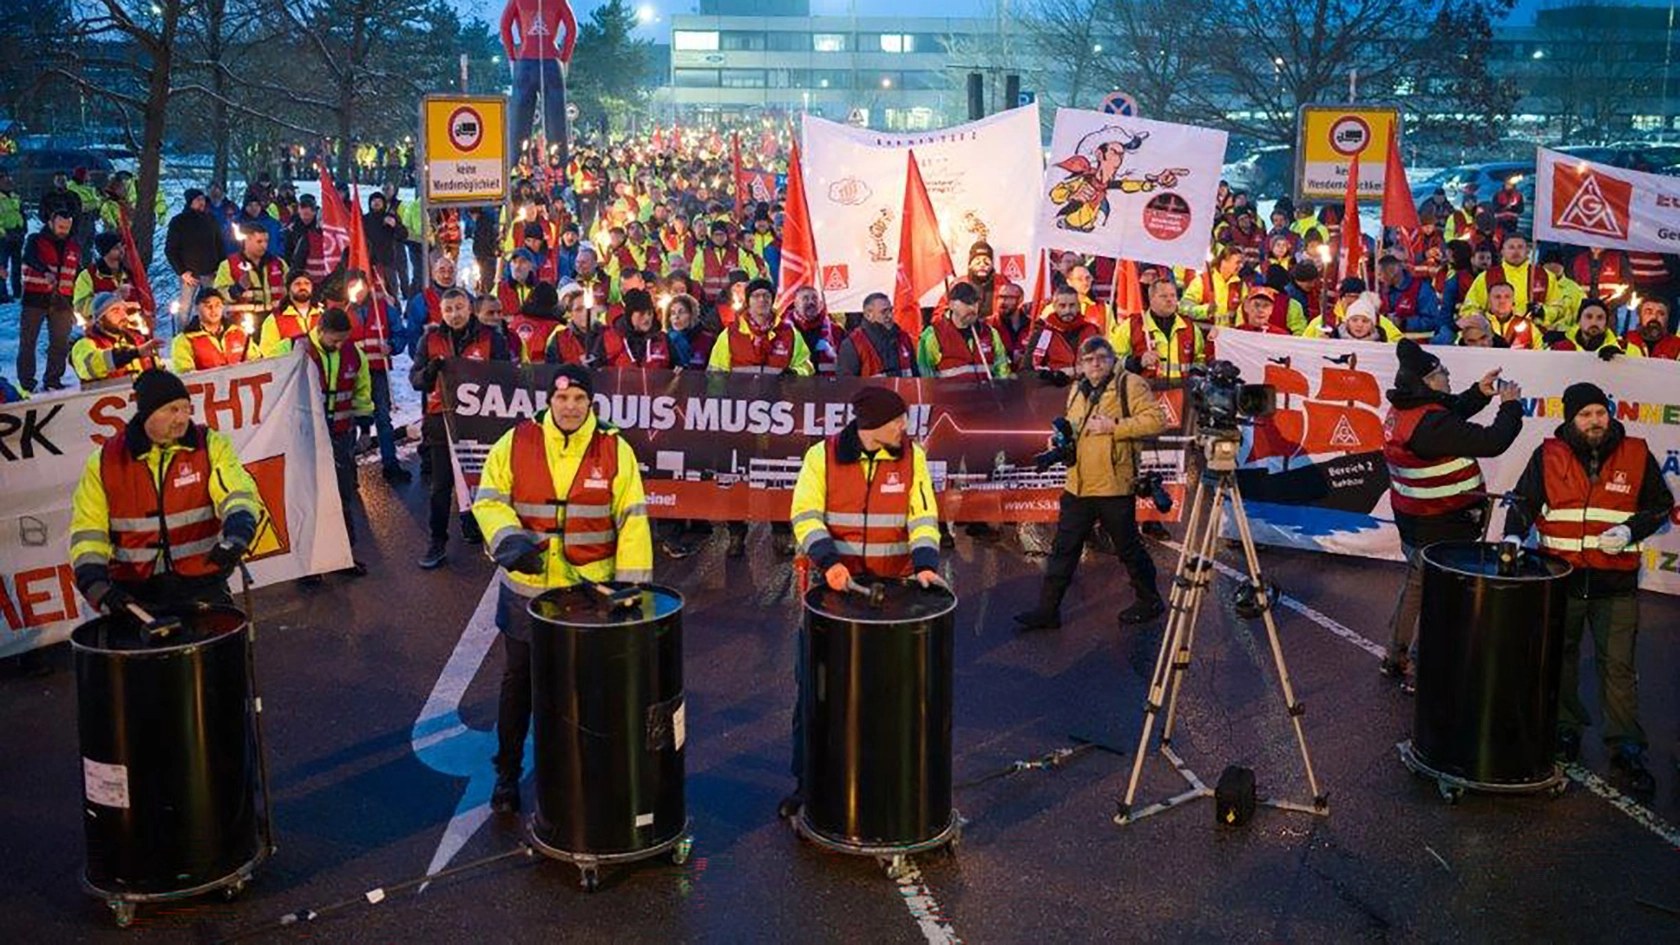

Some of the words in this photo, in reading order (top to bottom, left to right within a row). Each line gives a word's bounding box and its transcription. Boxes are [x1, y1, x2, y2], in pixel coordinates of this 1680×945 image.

[89, 372, 273, 446] SHT
[455, 383, 678, 431] SAAOUIS
[684, 397, 795, 435] MUSS
